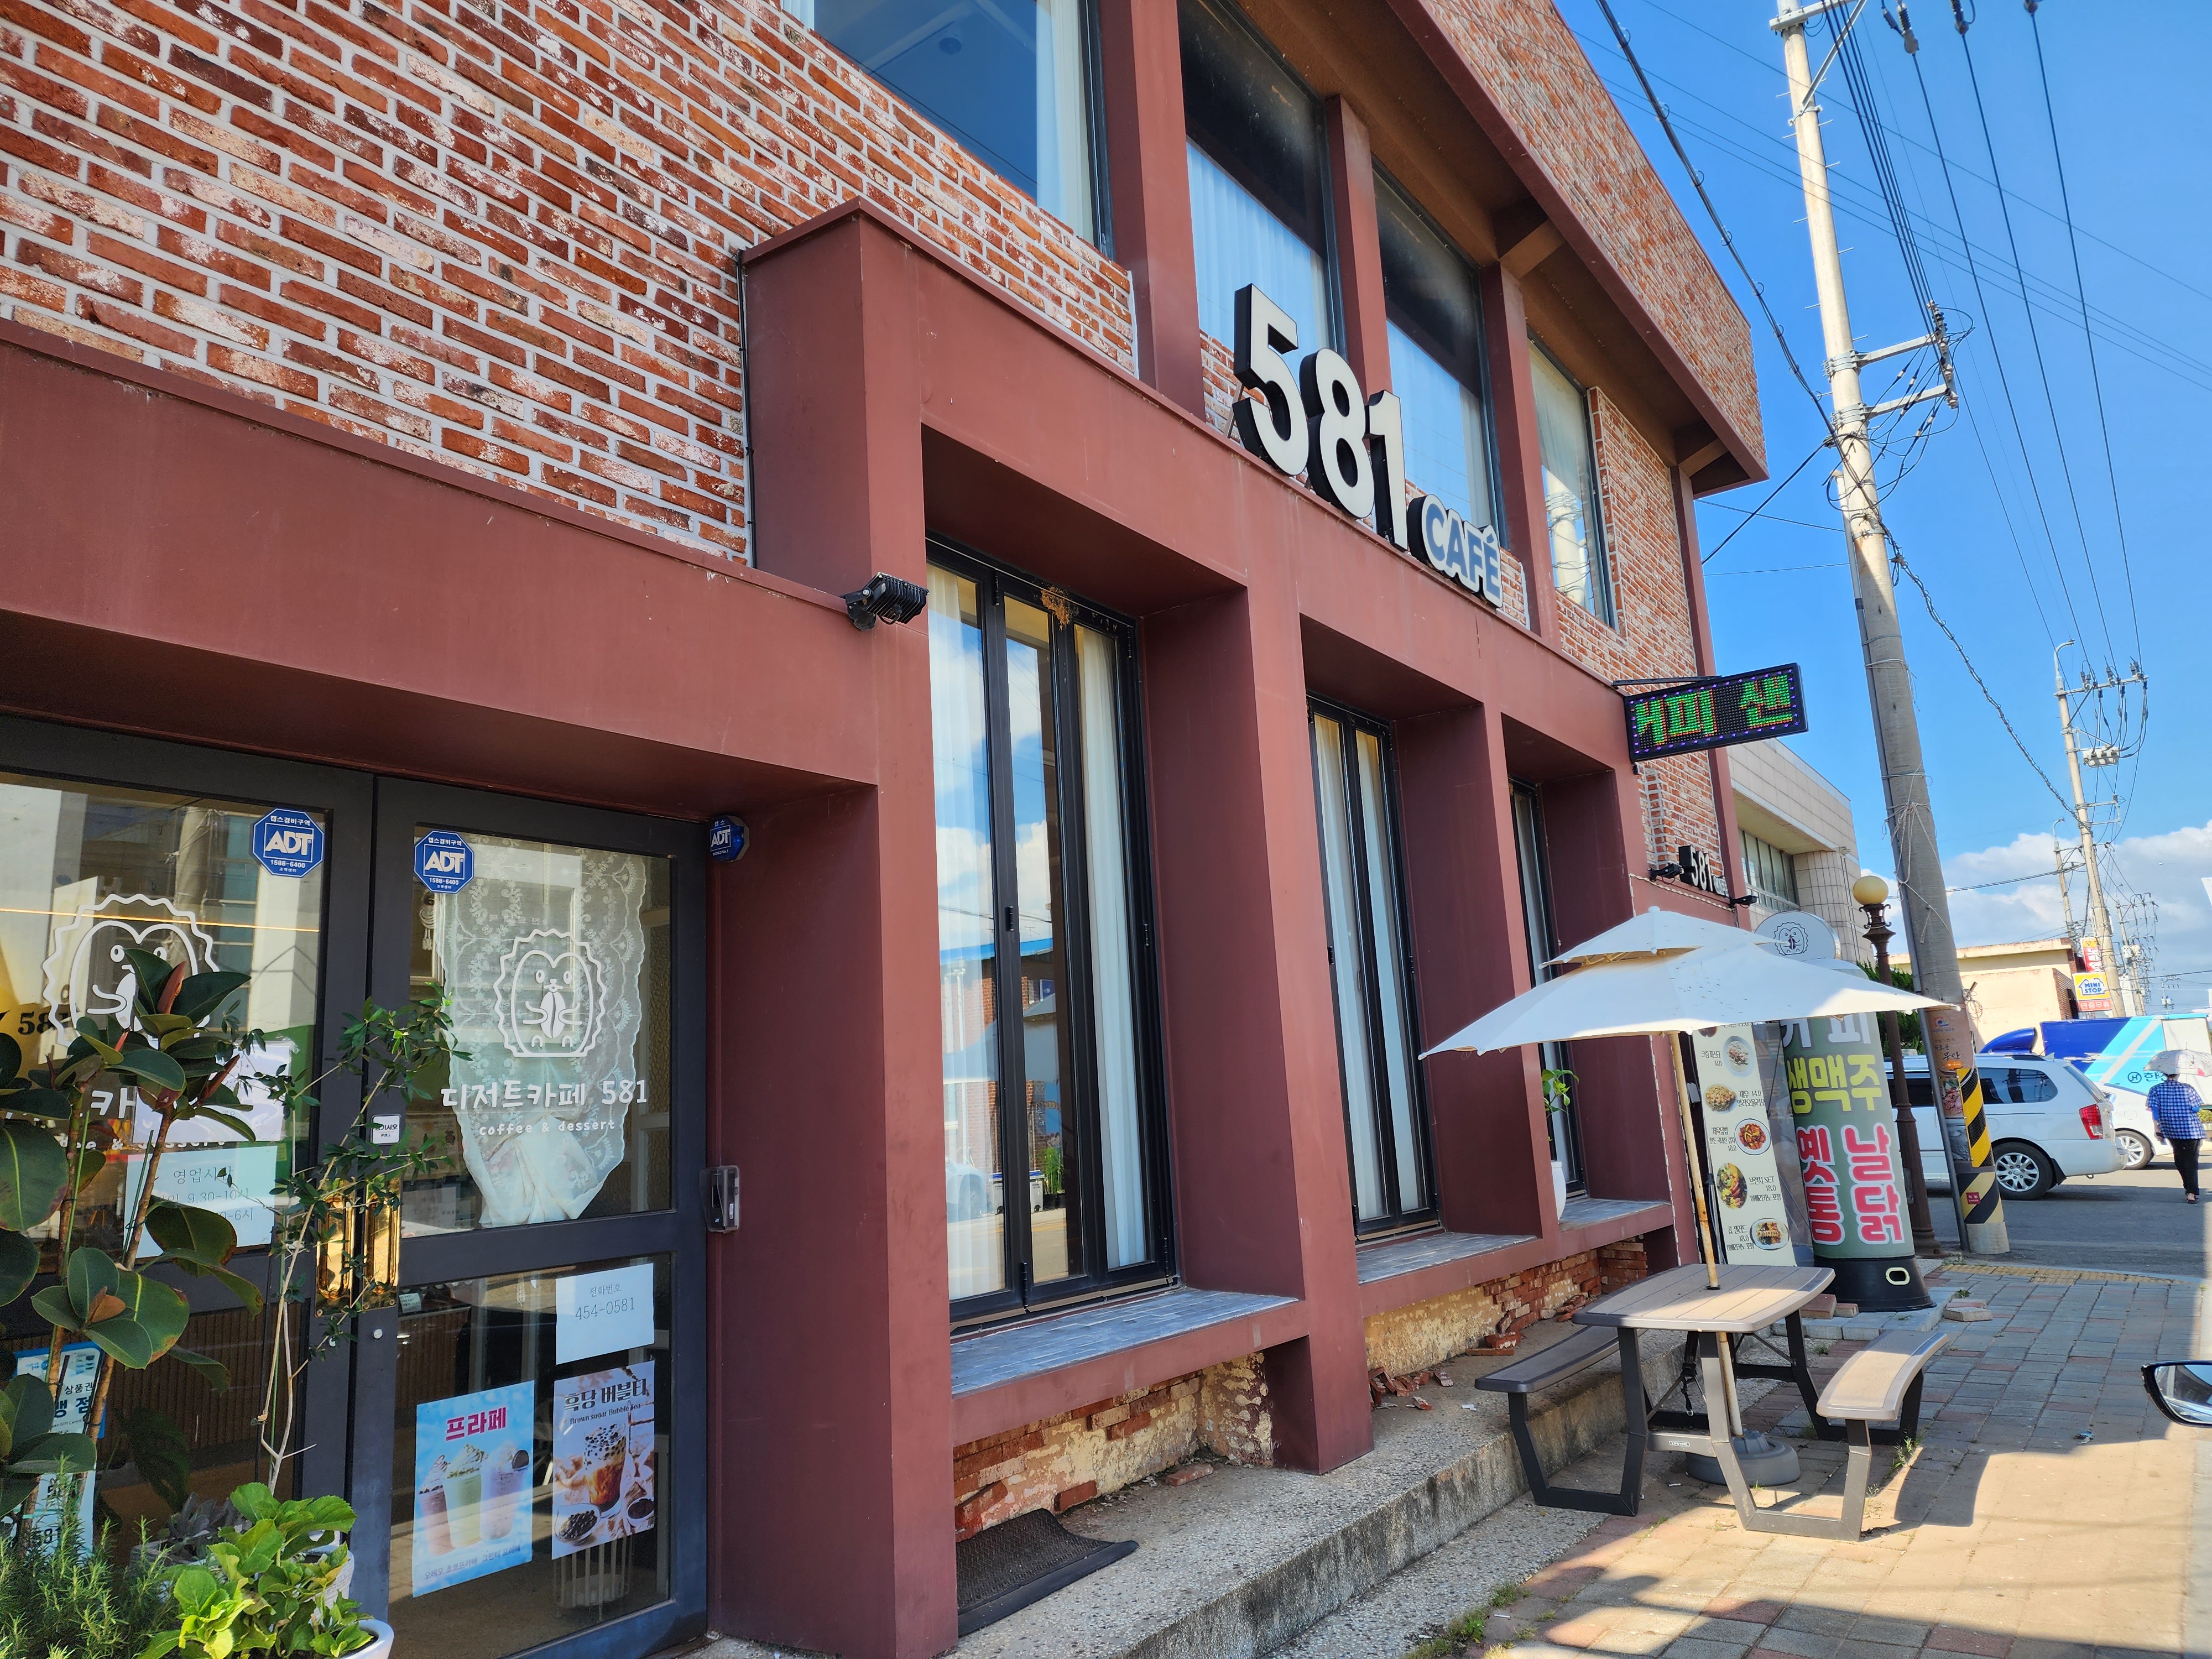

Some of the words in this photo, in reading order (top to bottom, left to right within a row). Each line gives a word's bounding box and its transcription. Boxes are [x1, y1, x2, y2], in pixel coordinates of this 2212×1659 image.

[1237, 283, 1408, 551] 581
[1421, 499, 1503, 608] CAFÉ
[270, 815, 310, 826] 캡스경비구역
[265, 831, 314, 855] ADT
[428, 837, 462, 846] 캡스경비구역
[711, 829, 730, 847] ADT
[270, 859, 305, 868] 1588-6400
[424, 851, 465, 873] ADT
[441, 1079, 585, 1110] 디저트카페
[602, 1079, 647, 1105] 581
[1787, 1054, 1882, 1114] 생맥주
[479, 1122, 533, 1135] coffee
[541, 1122, 549, 1132] &
[558, 1120, 615, 1132] dessert
[589, 1284, 622, 1297] 전화번호
[575, 1297, 635, 1320] 454-0581
[564, 1390, 597, 1411] 흑당
[601, 1379, 646, 1404] 버블티
[446, 1407, 507, 1441] 프라페
[570, 1416, 589, 1425] Brown
[590, 1411, 607, 1420] sugar
[609, 1406, 629, 1416] Bubble
